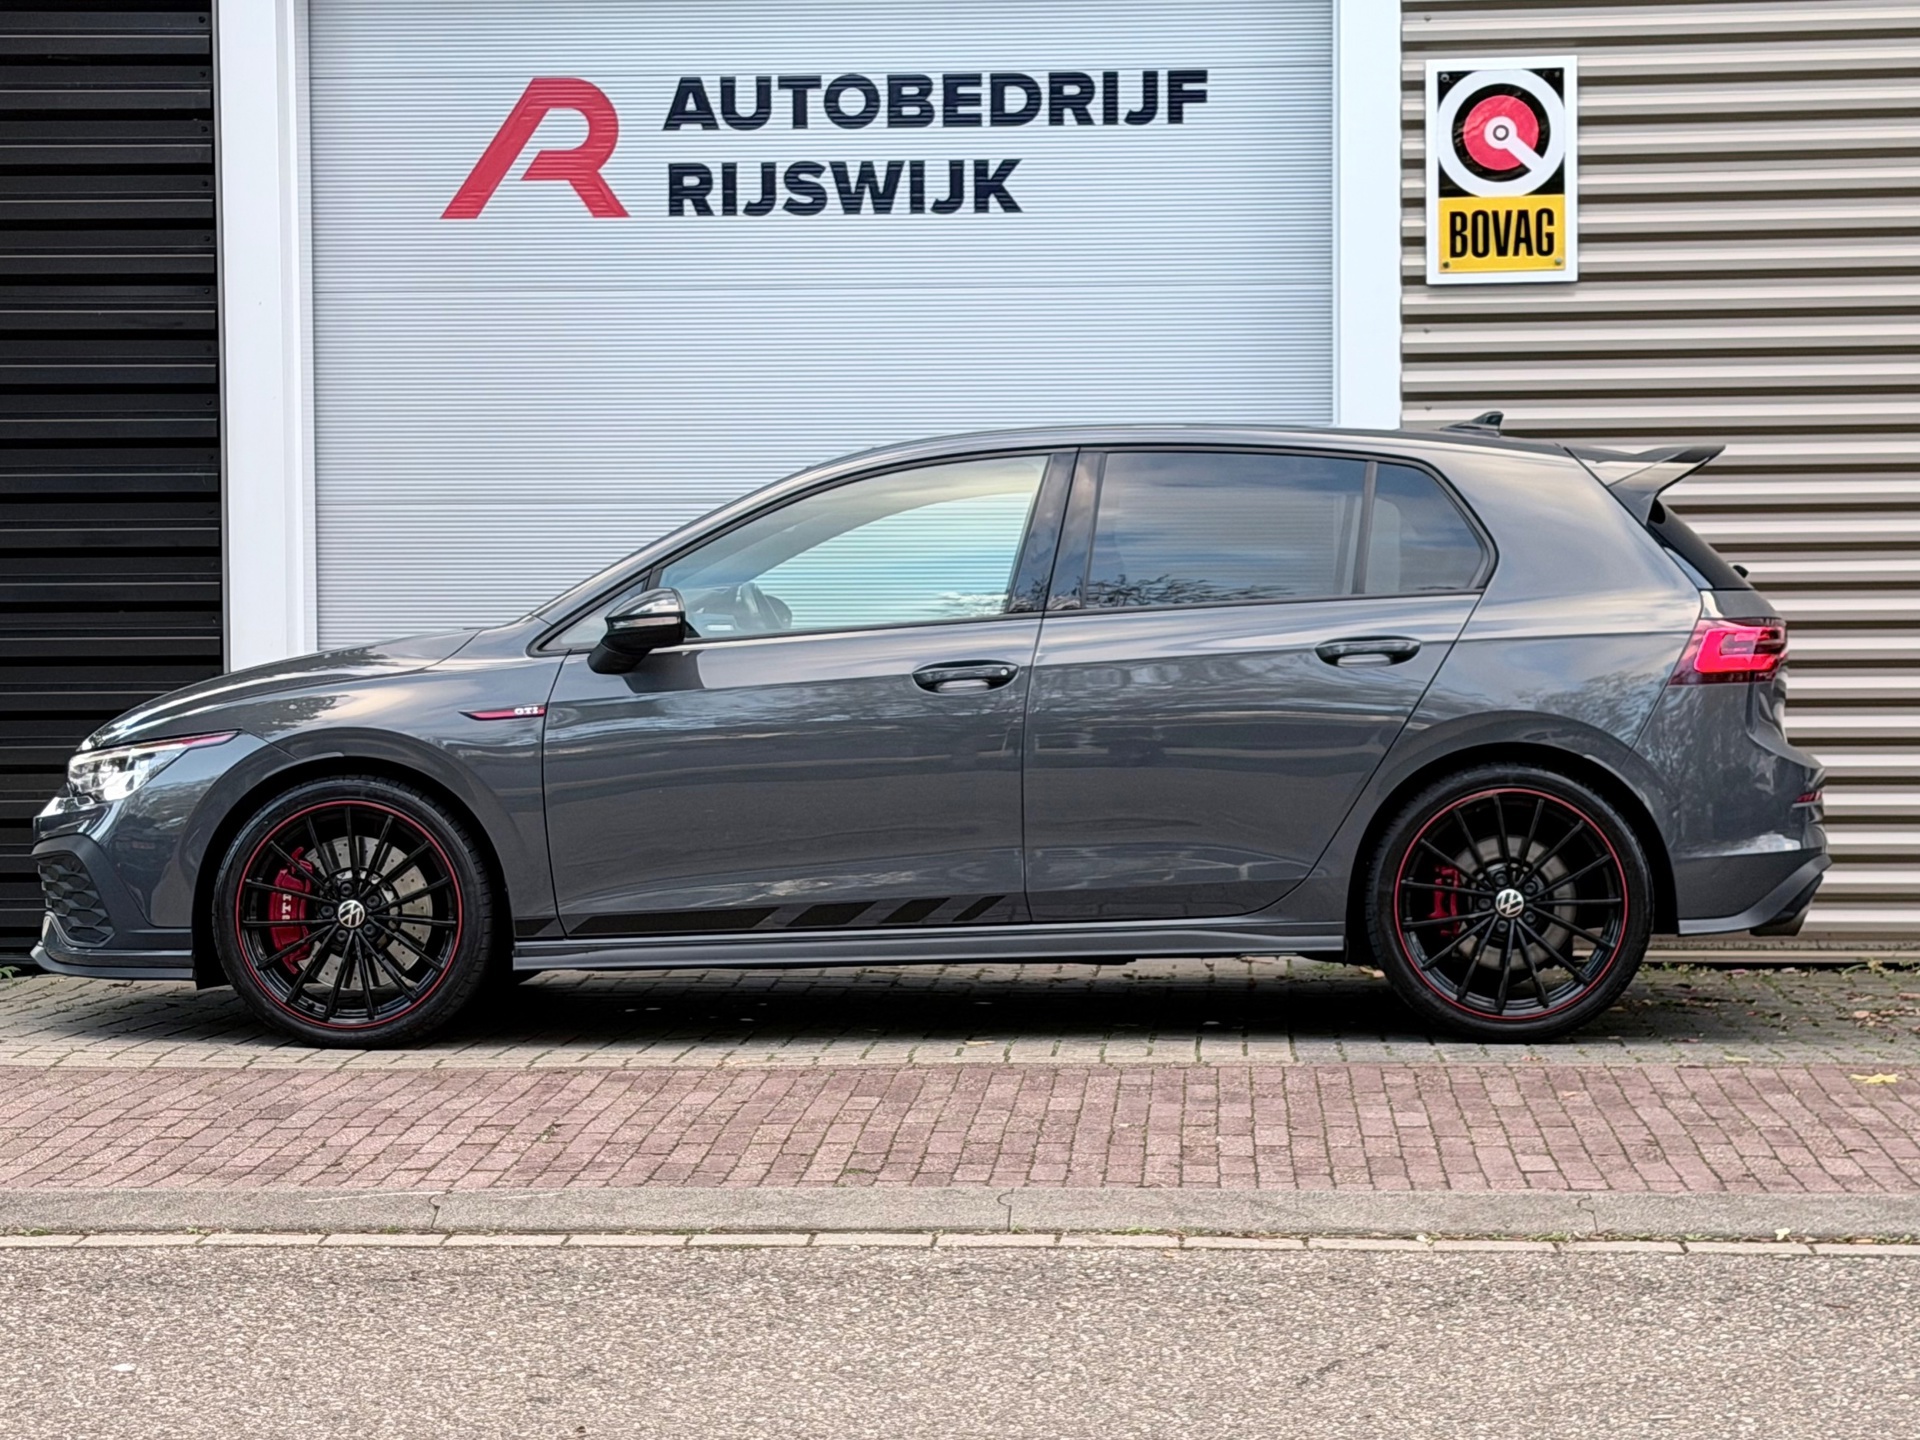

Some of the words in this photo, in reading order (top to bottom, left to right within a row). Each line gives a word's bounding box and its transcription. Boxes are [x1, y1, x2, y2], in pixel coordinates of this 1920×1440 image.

[663, 69, 1208, 131] AUTOBEDRIJF
[667, 158, 1023, 217] RIJSWIJK
[1449, 207, 1555, 259] BOVAG
[514, 706, 539, 716] GTI
